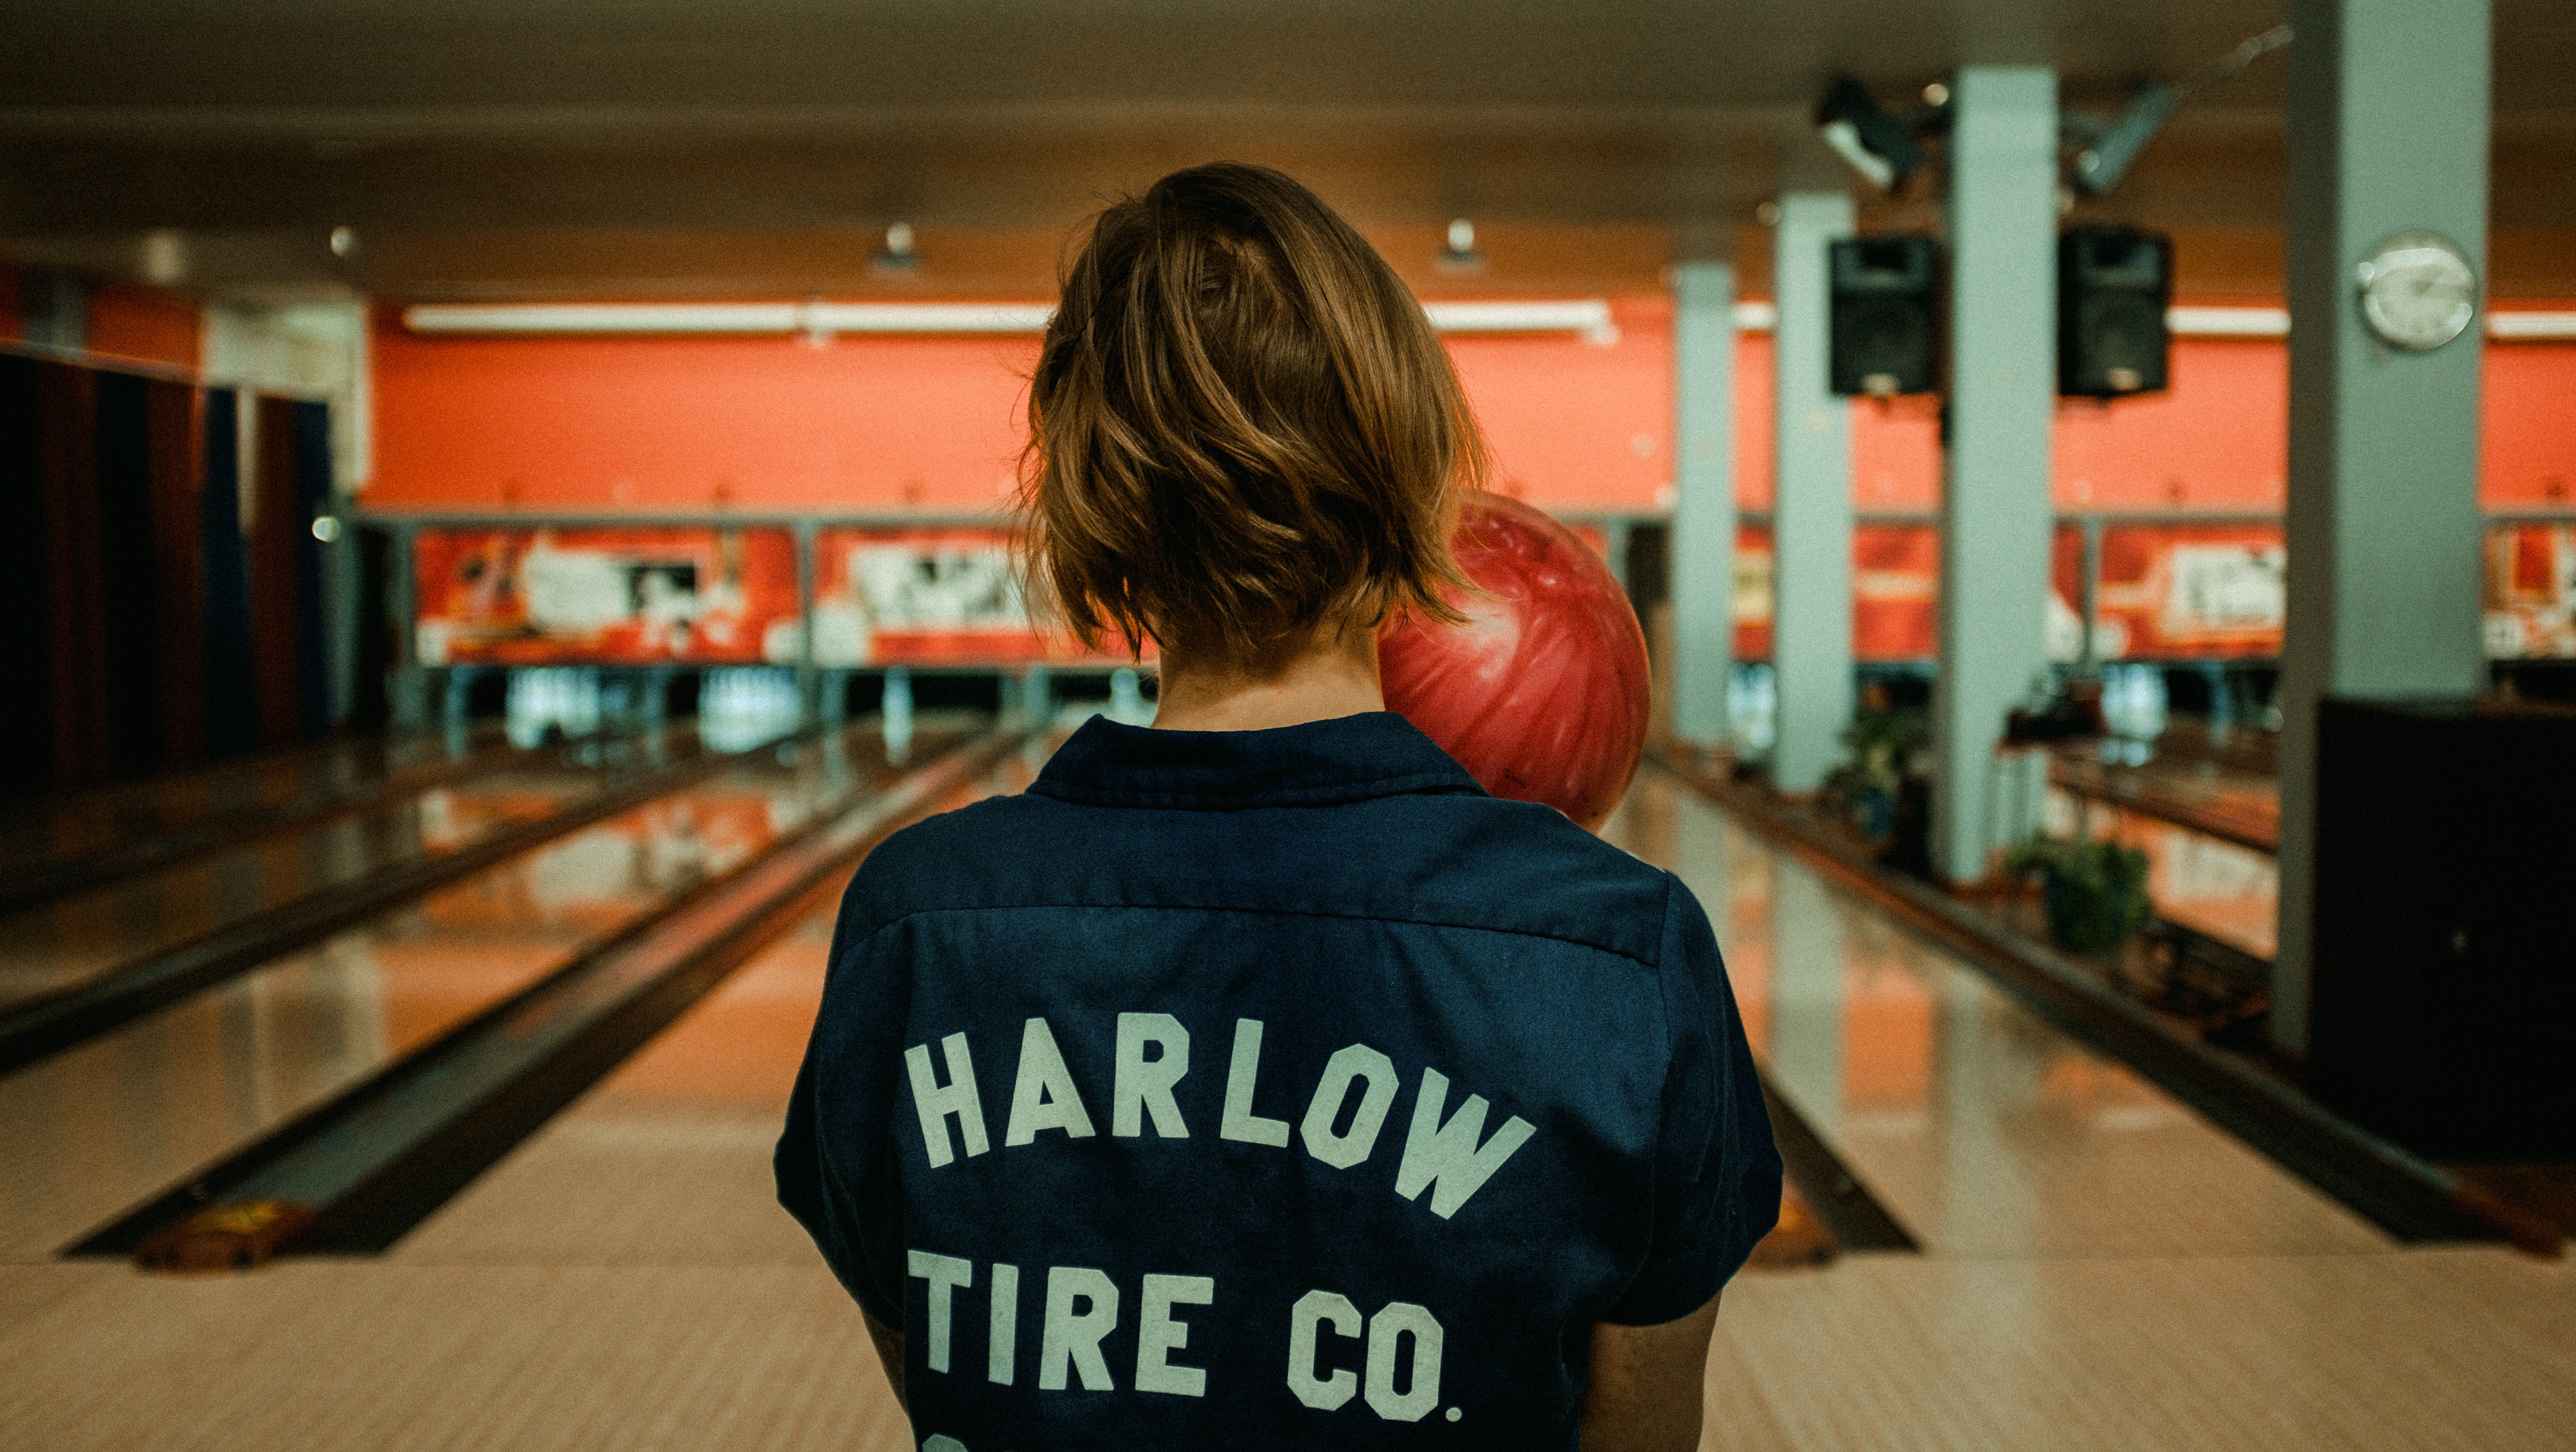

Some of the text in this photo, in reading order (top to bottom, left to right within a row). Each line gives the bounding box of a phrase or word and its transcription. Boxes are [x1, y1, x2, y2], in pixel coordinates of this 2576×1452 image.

[904, 1012, 1537, 1220] HARLOW
[907, 1249, 1463, 1423] TIRE CO.
